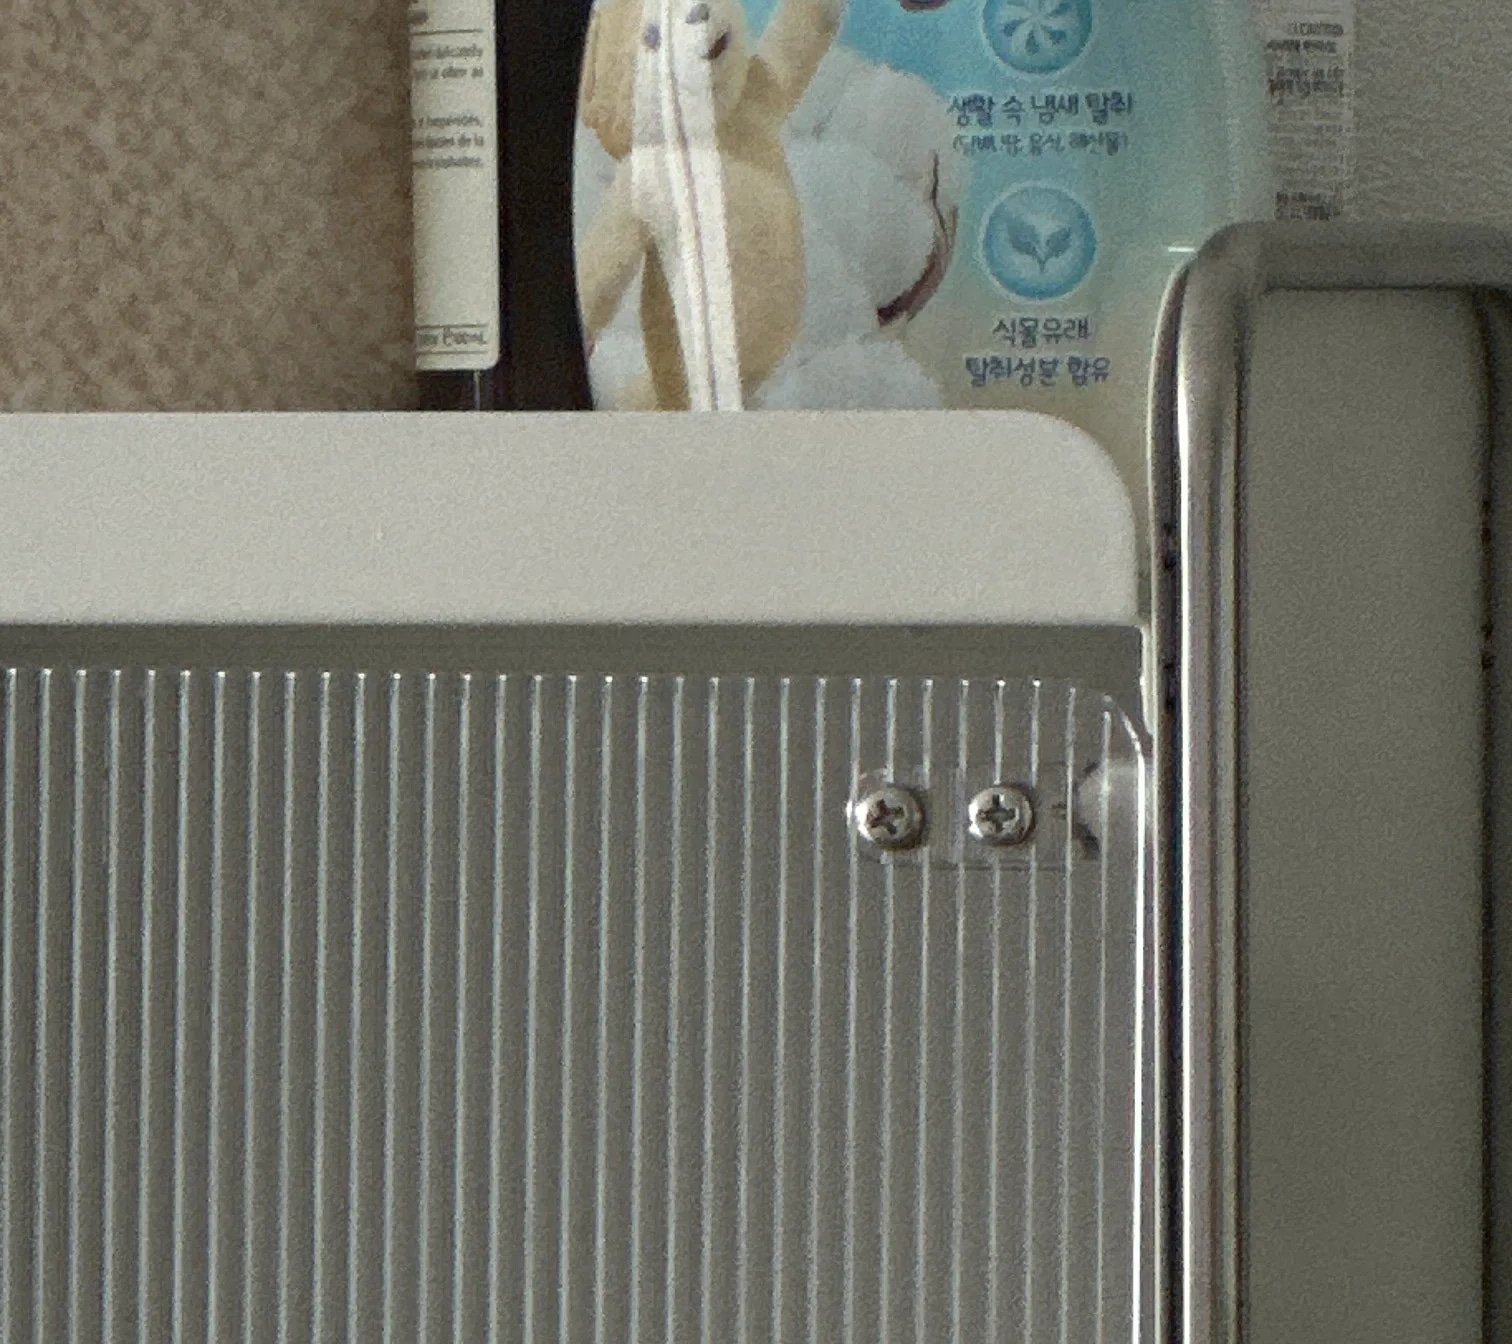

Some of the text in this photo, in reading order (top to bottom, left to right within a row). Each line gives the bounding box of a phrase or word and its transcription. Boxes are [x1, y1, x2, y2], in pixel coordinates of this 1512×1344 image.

[1001, 94, 1026, 127] 속
[1030, 92, 1080, 126] 냄새
[1085, 90, 1134, 126] 탈취
[992, 316, 1092, 349] 식물유래
[964, 356, 1061, 388] 탈취성분
